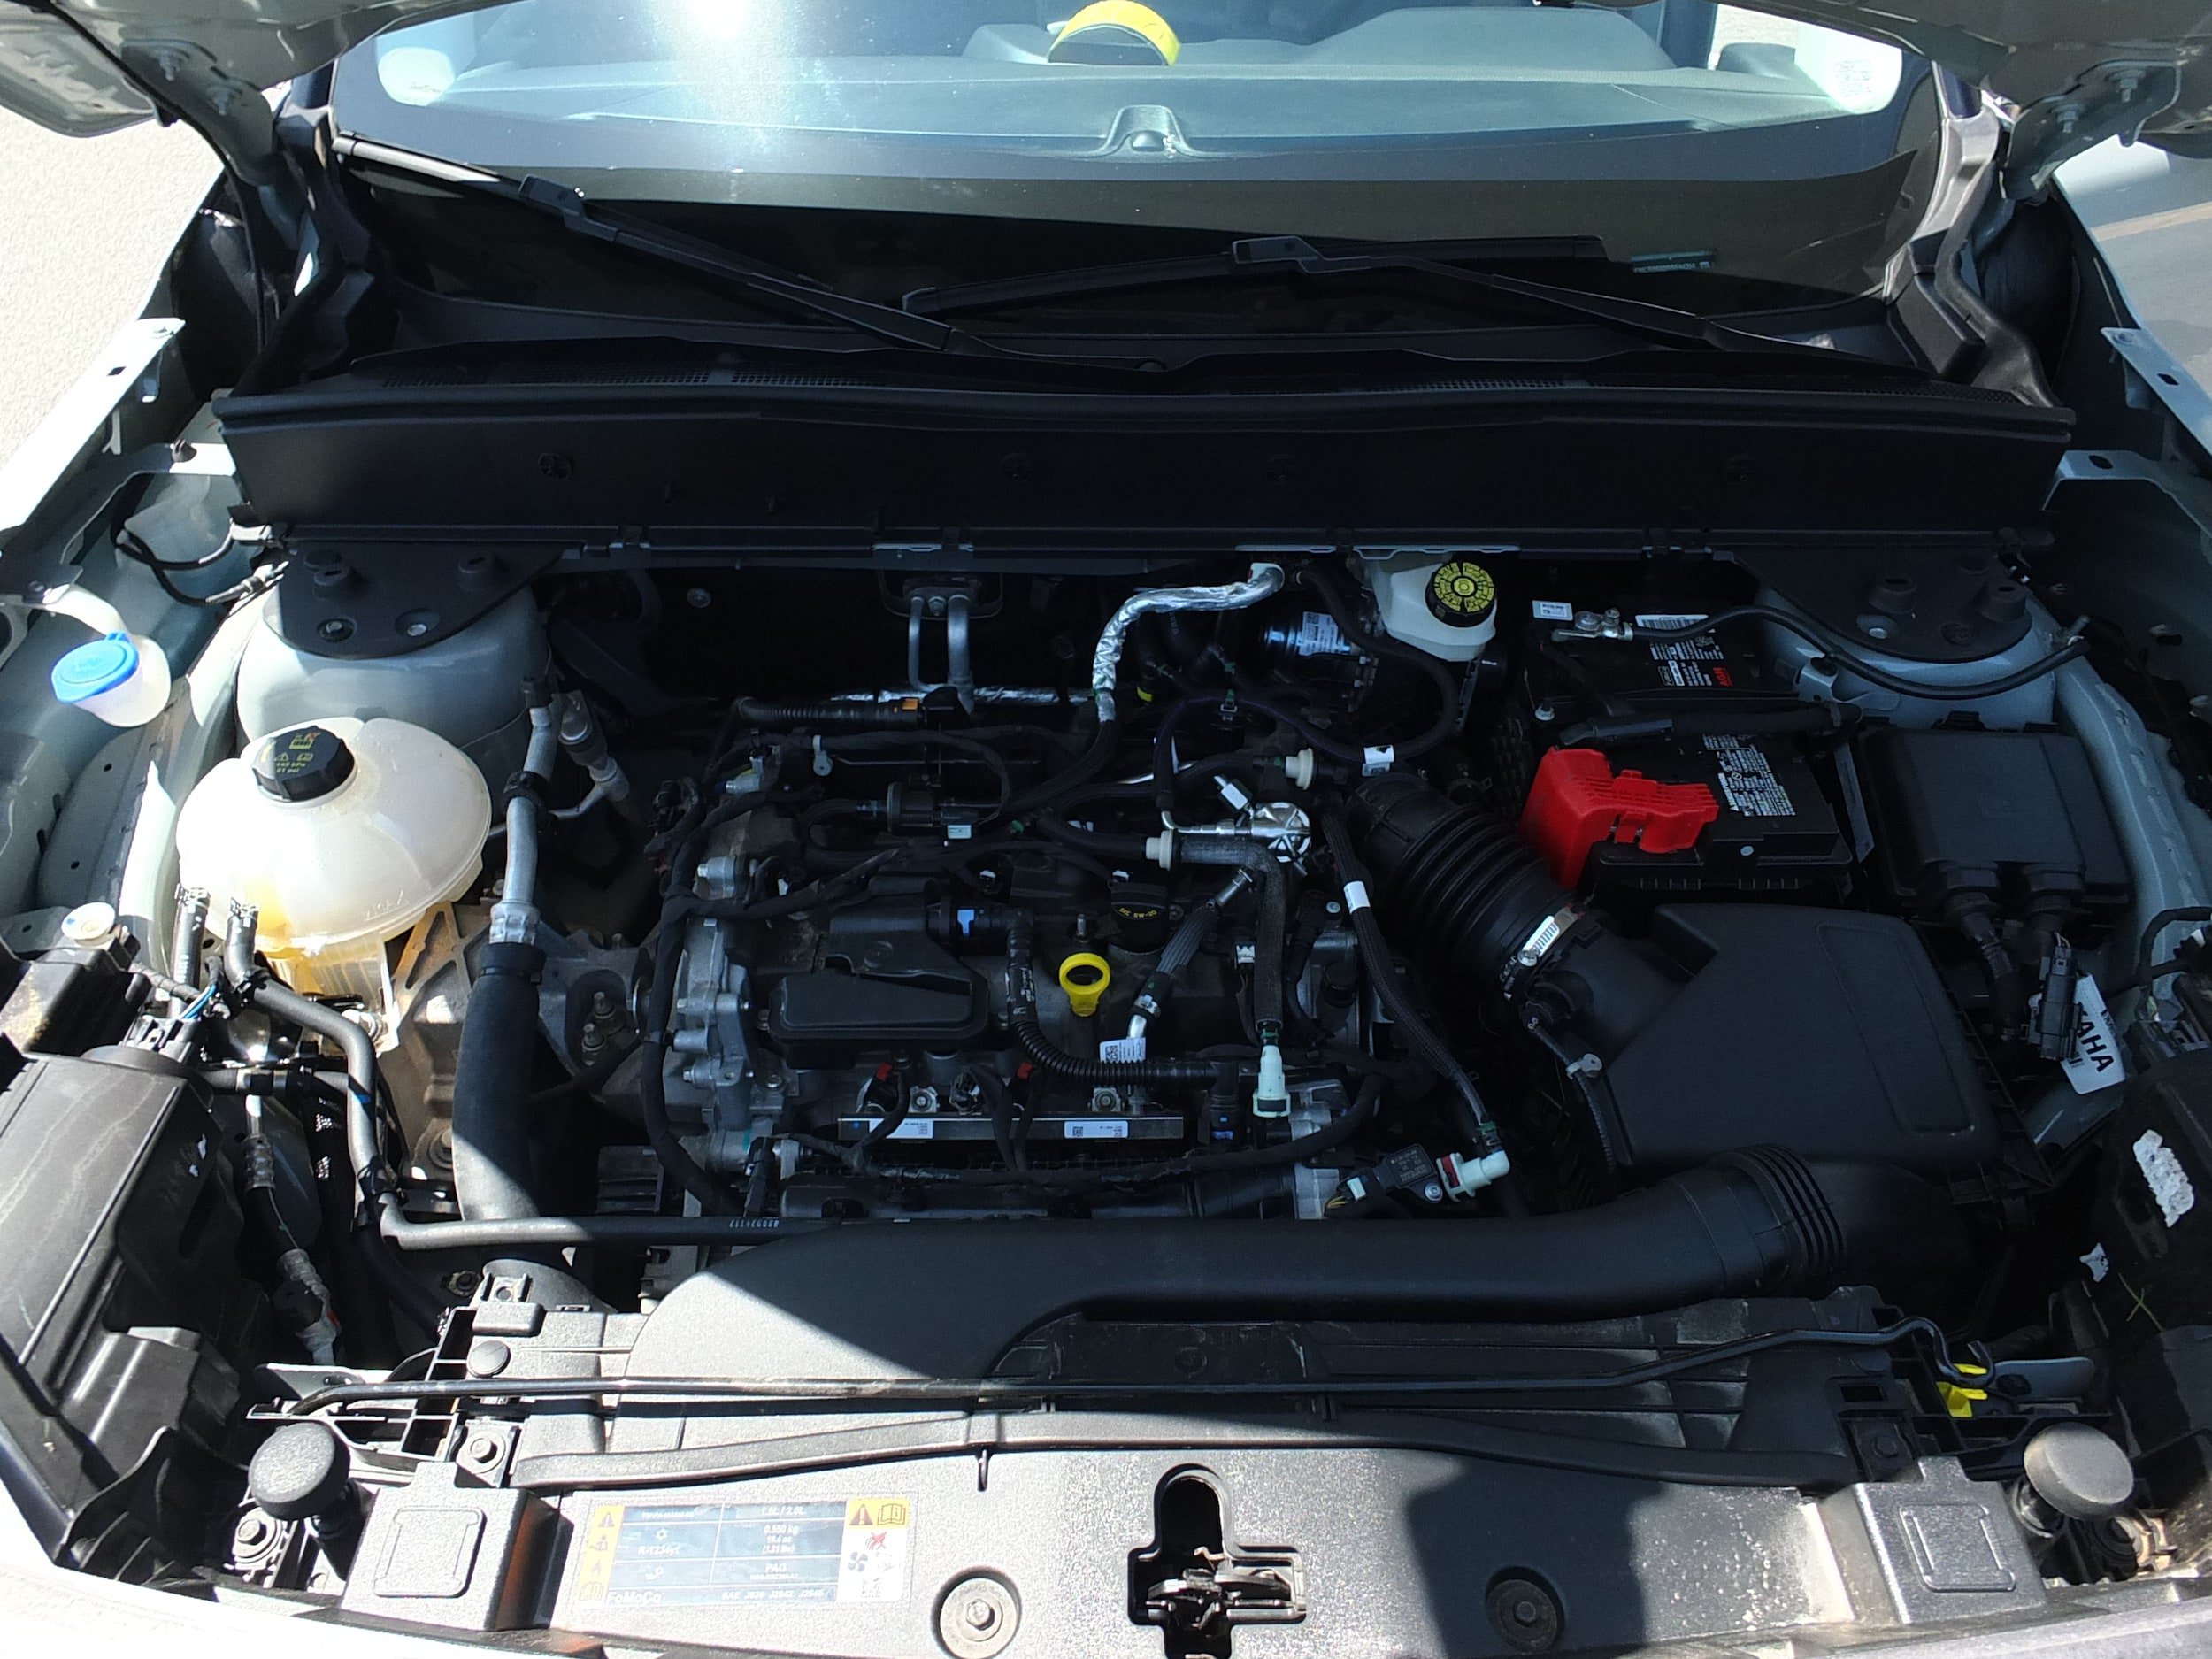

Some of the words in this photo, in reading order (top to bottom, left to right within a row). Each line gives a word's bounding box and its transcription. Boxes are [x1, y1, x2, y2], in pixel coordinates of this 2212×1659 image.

[2077, 1003, 2115, 1072] AHA
[787, 1524, 799, 1537] kg
[764, 1563, 787, 1573] PAG
[607, 1590, 662, 1604] FoMoCo
